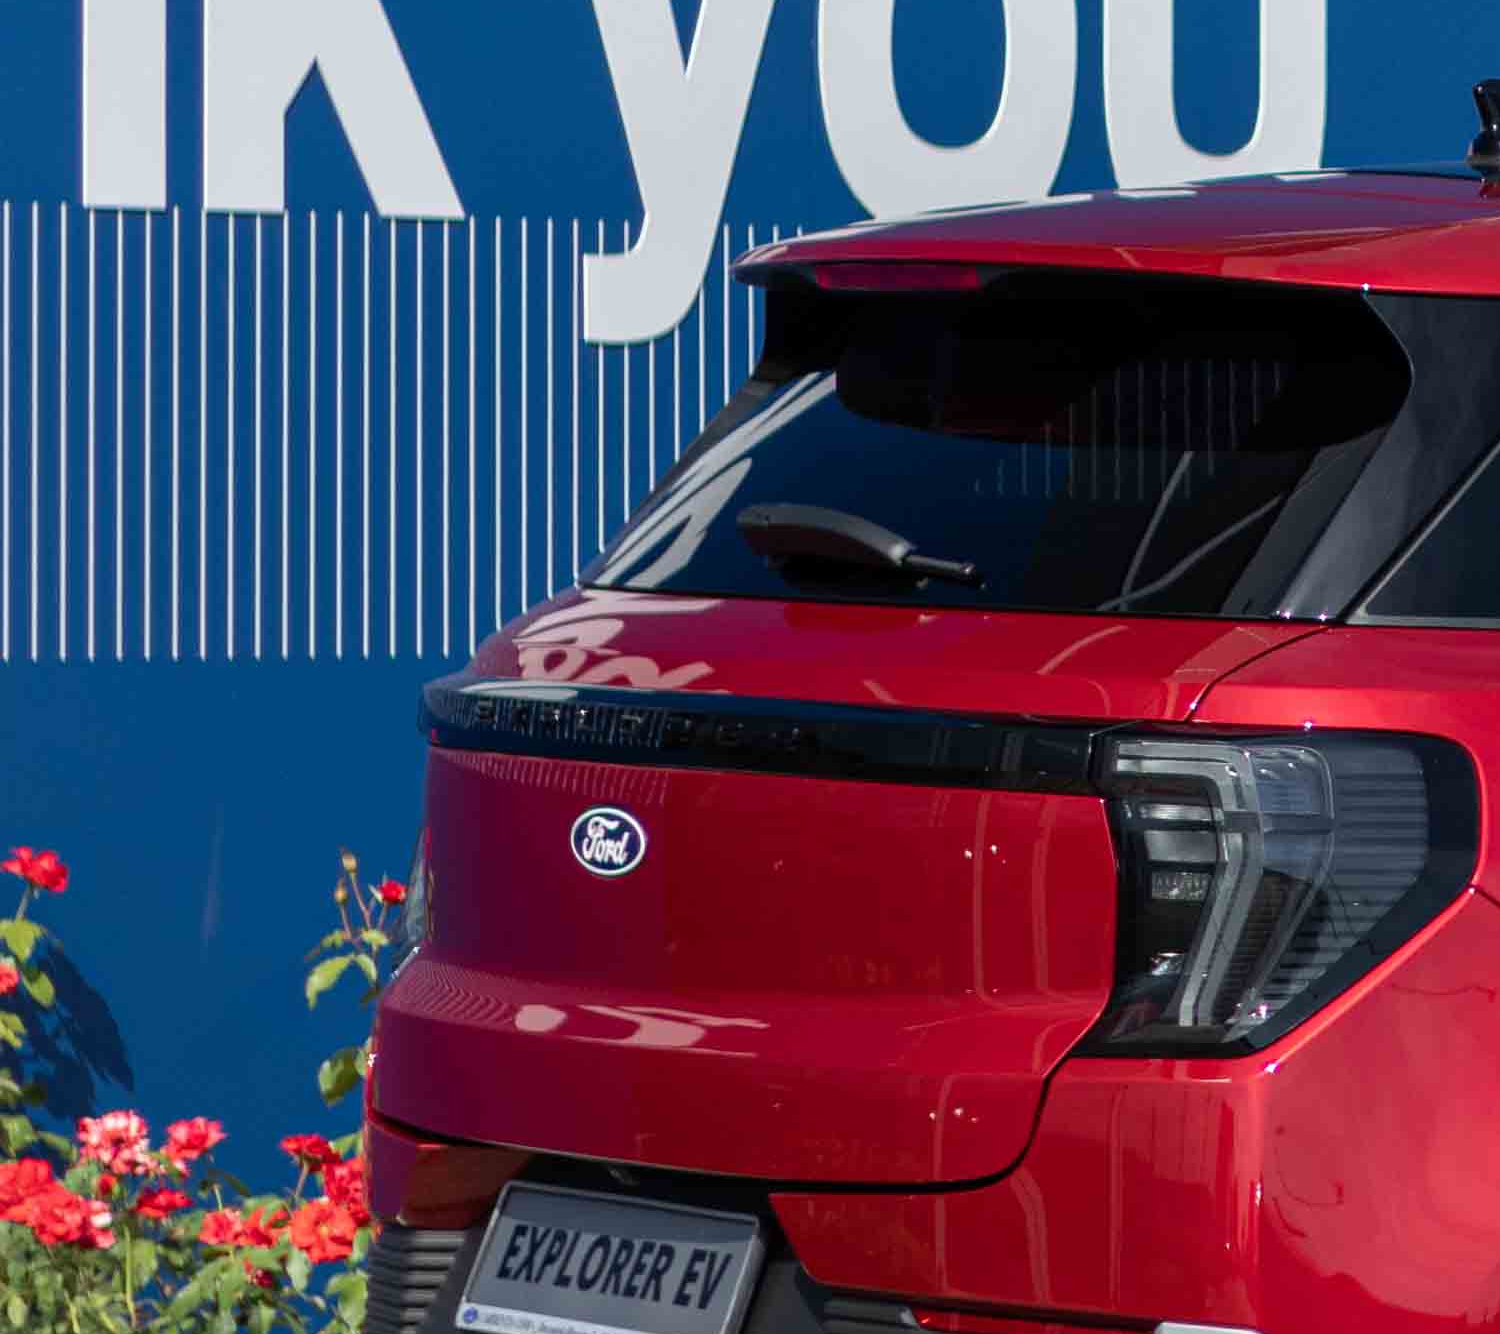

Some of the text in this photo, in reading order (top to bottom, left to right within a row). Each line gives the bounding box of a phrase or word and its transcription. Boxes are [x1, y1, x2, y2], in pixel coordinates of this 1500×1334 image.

[582, 815, 630, 864] Ford
[497, 1223, 733, 1310] EXPLORER EV
